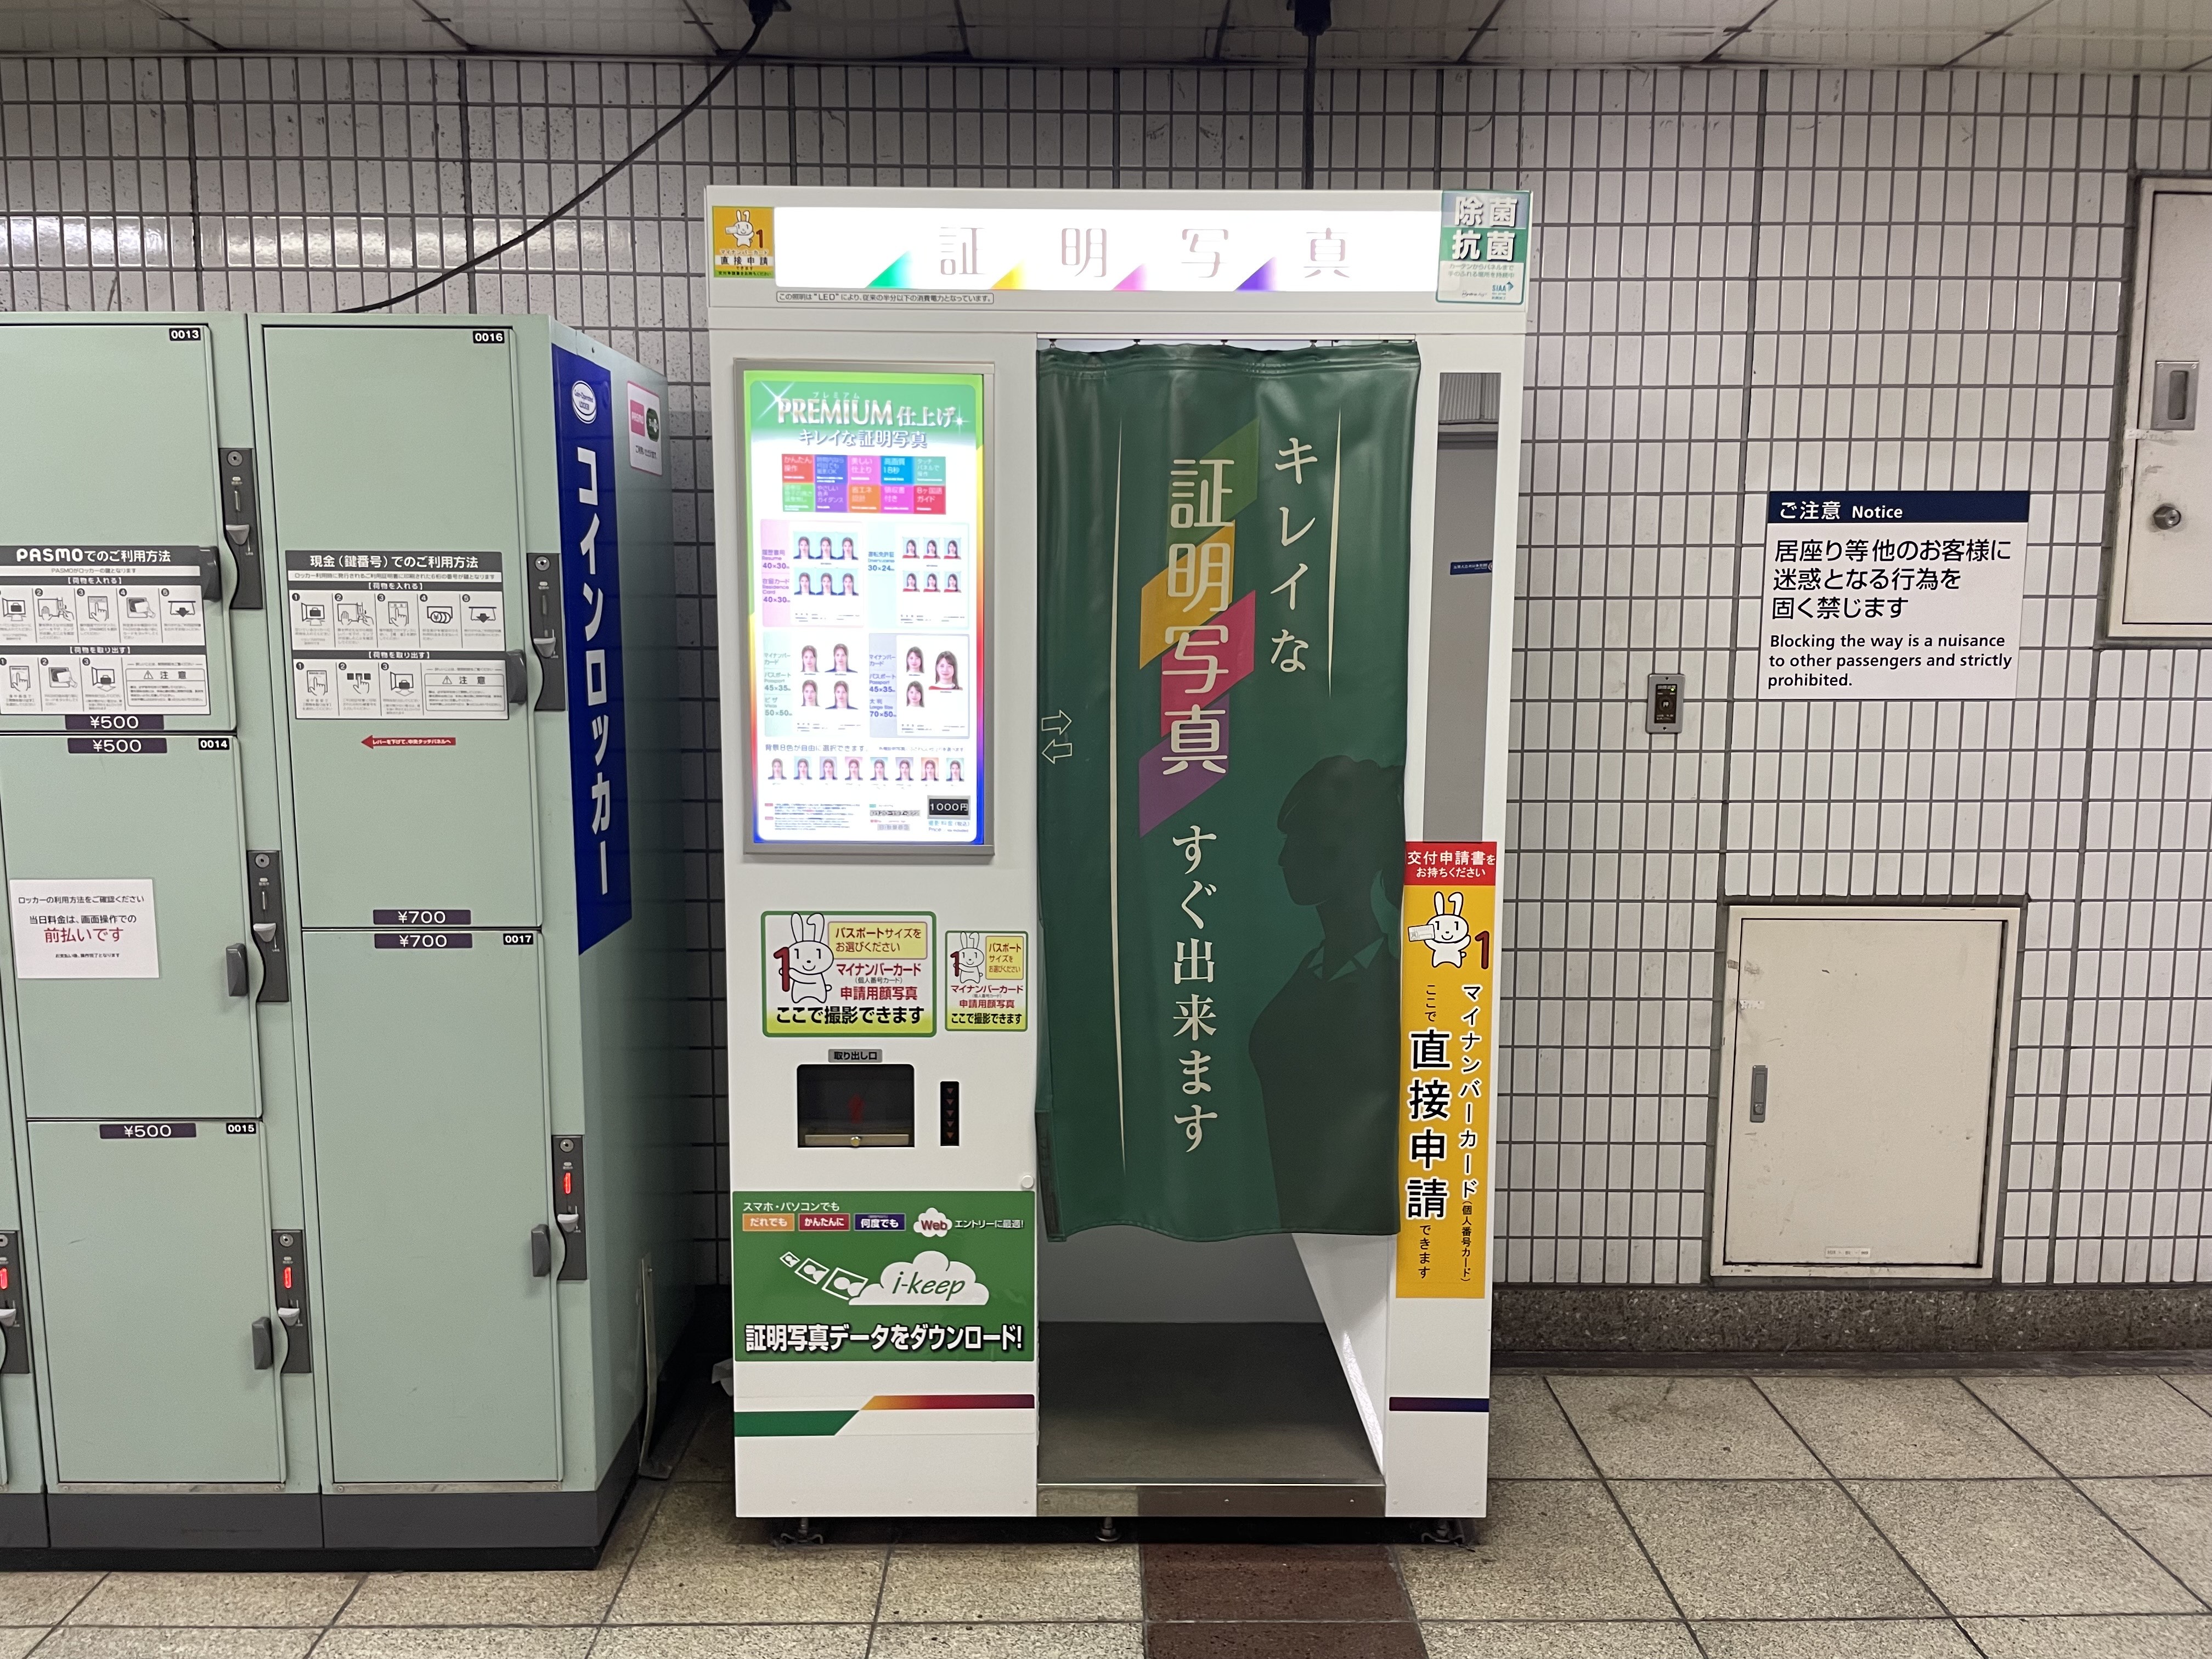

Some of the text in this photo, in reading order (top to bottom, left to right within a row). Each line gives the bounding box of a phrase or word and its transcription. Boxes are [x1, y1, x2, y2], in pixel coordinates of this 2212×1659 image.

[1454, 196, 1518, 227] 除菌
[1452, 230, 1515, 261] 抗菌
[939, 227, 1350, 278] 証明写真
[720, 256, 768, 266] 直接申請
[171, 330, 199, 340] 0013
[475, 333, 503, 342] 0016
[778, 399, 893, 425] PREMIUM
[897, 406, 956, 427] 仕上げ
[799, 430, 928, 448] キレイな証明写真
[1781, 501, 1903, 520] ご注意 Notice
[16, 549, 171, 562] PASMOでのご利用方法
[310, 555, 478, 568] 現金（鍵番号）でのご利用方法
[1270, 437, 1318, 673] キレイな
[1773, 568, 1961, 591] 迷惑となる行為を
[1772, 597, 1908, 620] 固く禁じます
[1161, 459, 1235, 776] 証明写真
[1771, 635, 2005, 651] Blocking the way is a nuisance
[1770, 654, 2012, 670] to other passengers and strictly
[578, 447, 611, 895] コインロッカー
[1768, 674, 1852, 690] prohibited.
[90, 716, 138, 729] ¥500
[93, 740, 142, 752] ¥500
[201, 740, 227, 748] 0014
[930, 803, 968, 811] 1000円
[1407, 850, 1496, 866] 交付申請書を
[1416, 867, 1486, 878] お持ちください
[29, 915, 137, 924] 当日料金は、画面操作での
[398, 911, 446, 923] ¥700
[44, 927, 123, 943] 前払いです
[505, 935, 531, 944] 0017
[836, 928, 921, 939] パスポートサイズを
[399, 935, 447, 947] ¥700
[836, 942, 900, 952] お選びください
[989, 943, 1022, 952] パスポート
[989, 955, 1013, 963] サイズを
[836, 963, 921, 976] マイナンバーカード
[841, 986, 918, 1001] 申請用顔写真
[951, 985, 1023, 994] マイナンバーカード
[1172, 825, 1218, 1153] すぐ出来ます
[960, 1000, 1014, 1008] 申請用顔写真
[1425, 985, 1436, 1022] ここで
[777, 1006, 924, 1024] ここで撮影できます
[951, 1013, 1022, 1024] ここで撮影できます
[834, 1052, 877, 1060] 取り出し口
[1460, 986, 1481, 1198] マイナンバーカード
[228, 1125, 255, 1133] 0015
[1407, 1029, 1451, 1217] 直接申請
[124, 1124, 172, 1137] ¥500
[743, 1202, 839, 1211] スマホ・パソコンでも
[750, 1218, 788, 1227] だれでも
[805, 1217, 844, 1227] かんたんに
[861, 1218, 899, 1228] 何度でも
[921, 1220, 1024, 1231] Web エントリーに最適!
[1419, 1224, 1431, 1278] できます
[893, 1271, 966, 1301] i-keep
[745, 1324, 1023, 1352] 証明写真データをダウンロード!
